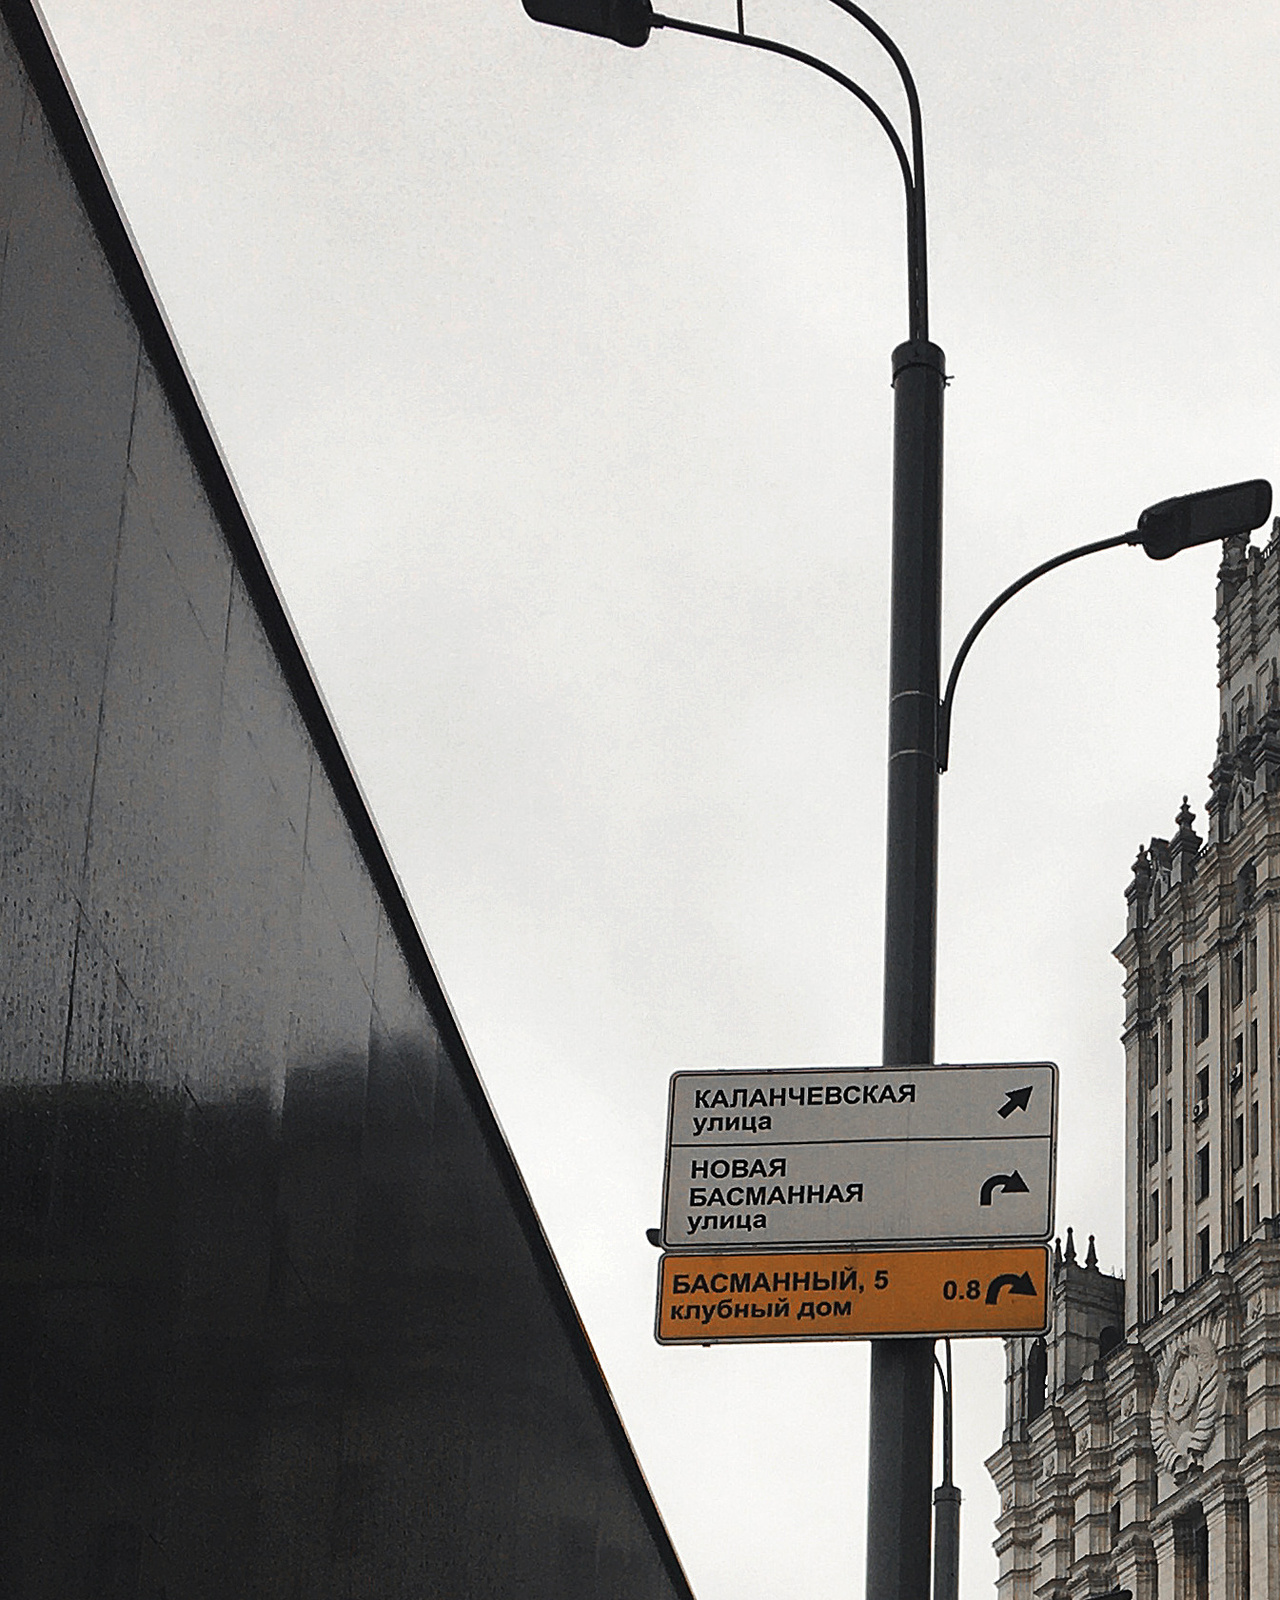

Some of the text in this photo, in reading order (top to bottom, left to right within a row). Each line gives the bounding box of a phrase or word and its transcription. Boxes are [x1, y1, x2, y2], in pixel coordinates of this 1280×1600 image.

[695, 1084, 916, 1109] КАЛАНЧЕВСКАЯ
[692, 1115, 773, 1136] улица
[690, 1158, 787, 1179] НОВАЯ
[689, 1183, 864, 1207] БАСМАННАЯ
[686, 1213, 768, 1235] улица
[672, 1266, 889, 1295] БАСМАННЫЙ, 5
[942, 1279, 982, 1301] 0.8
[670, 1299, 853, 1325] клубный дом
